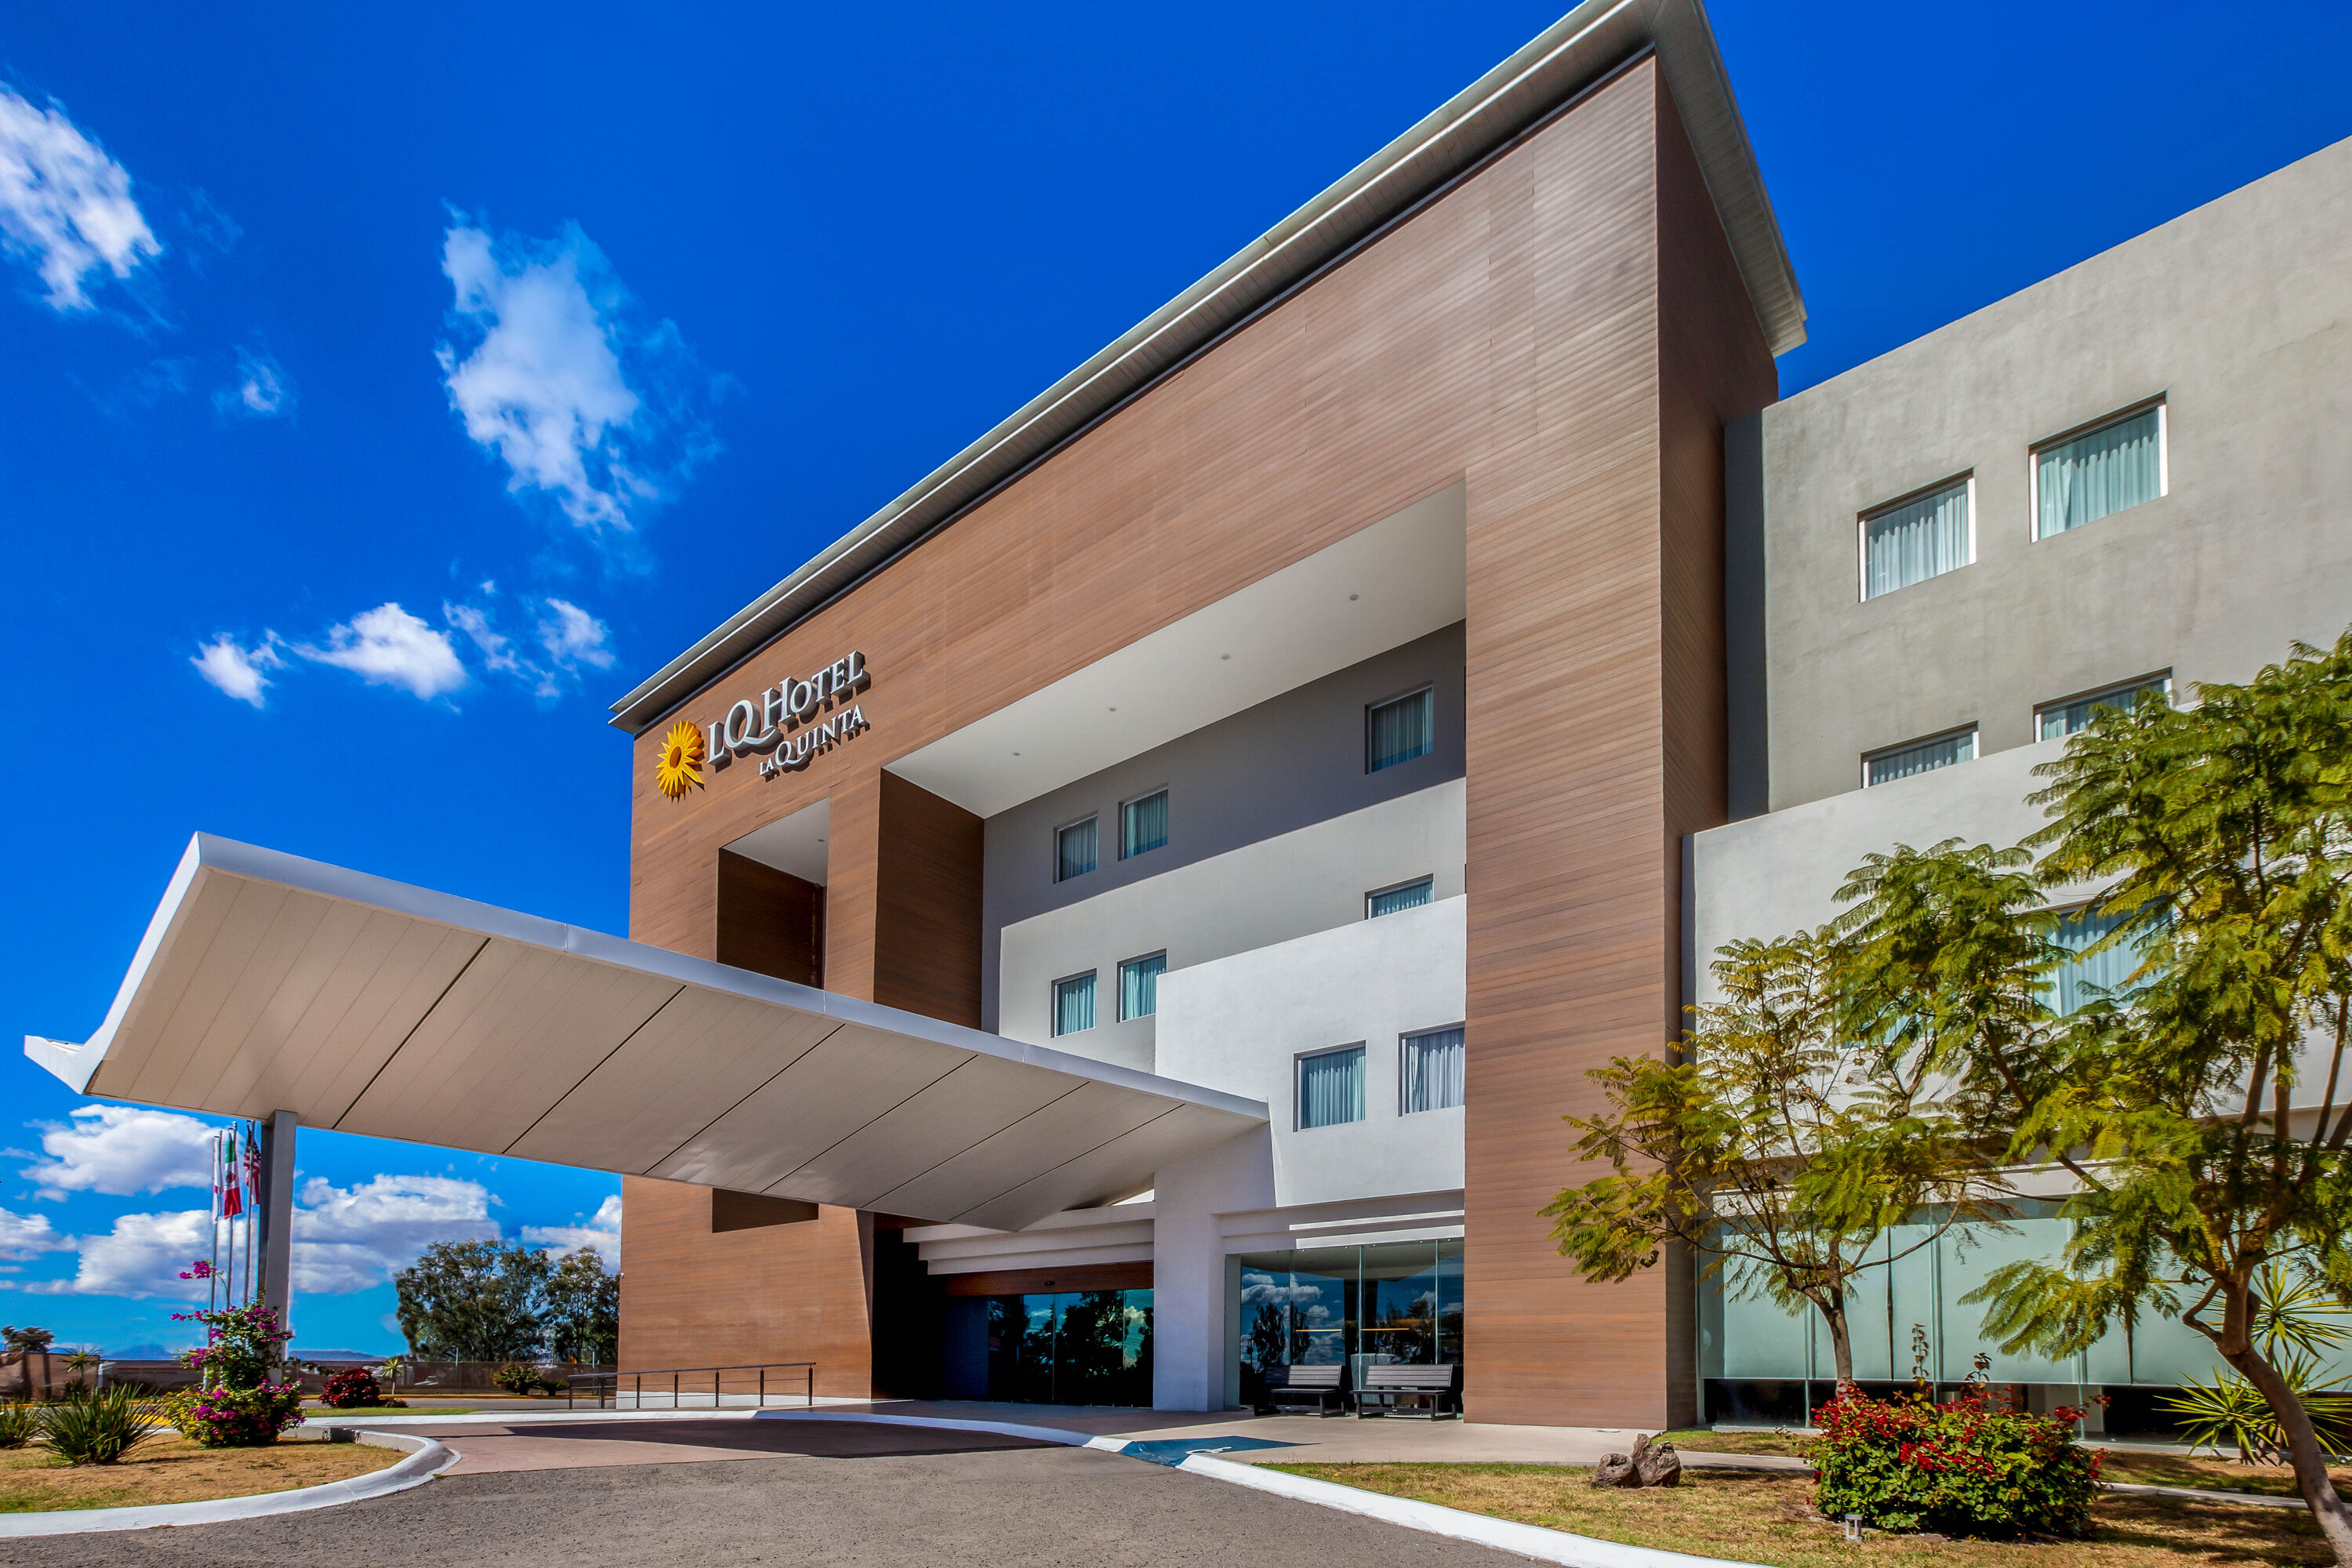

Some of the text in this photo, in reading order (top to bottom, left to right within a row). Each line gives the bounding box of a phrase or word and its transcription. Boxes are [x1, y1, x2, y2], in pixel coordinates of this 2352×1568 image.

[707, 650, 864, 764] LQ HOTEL
[759, 704, 866, 776] LA QUINTA
